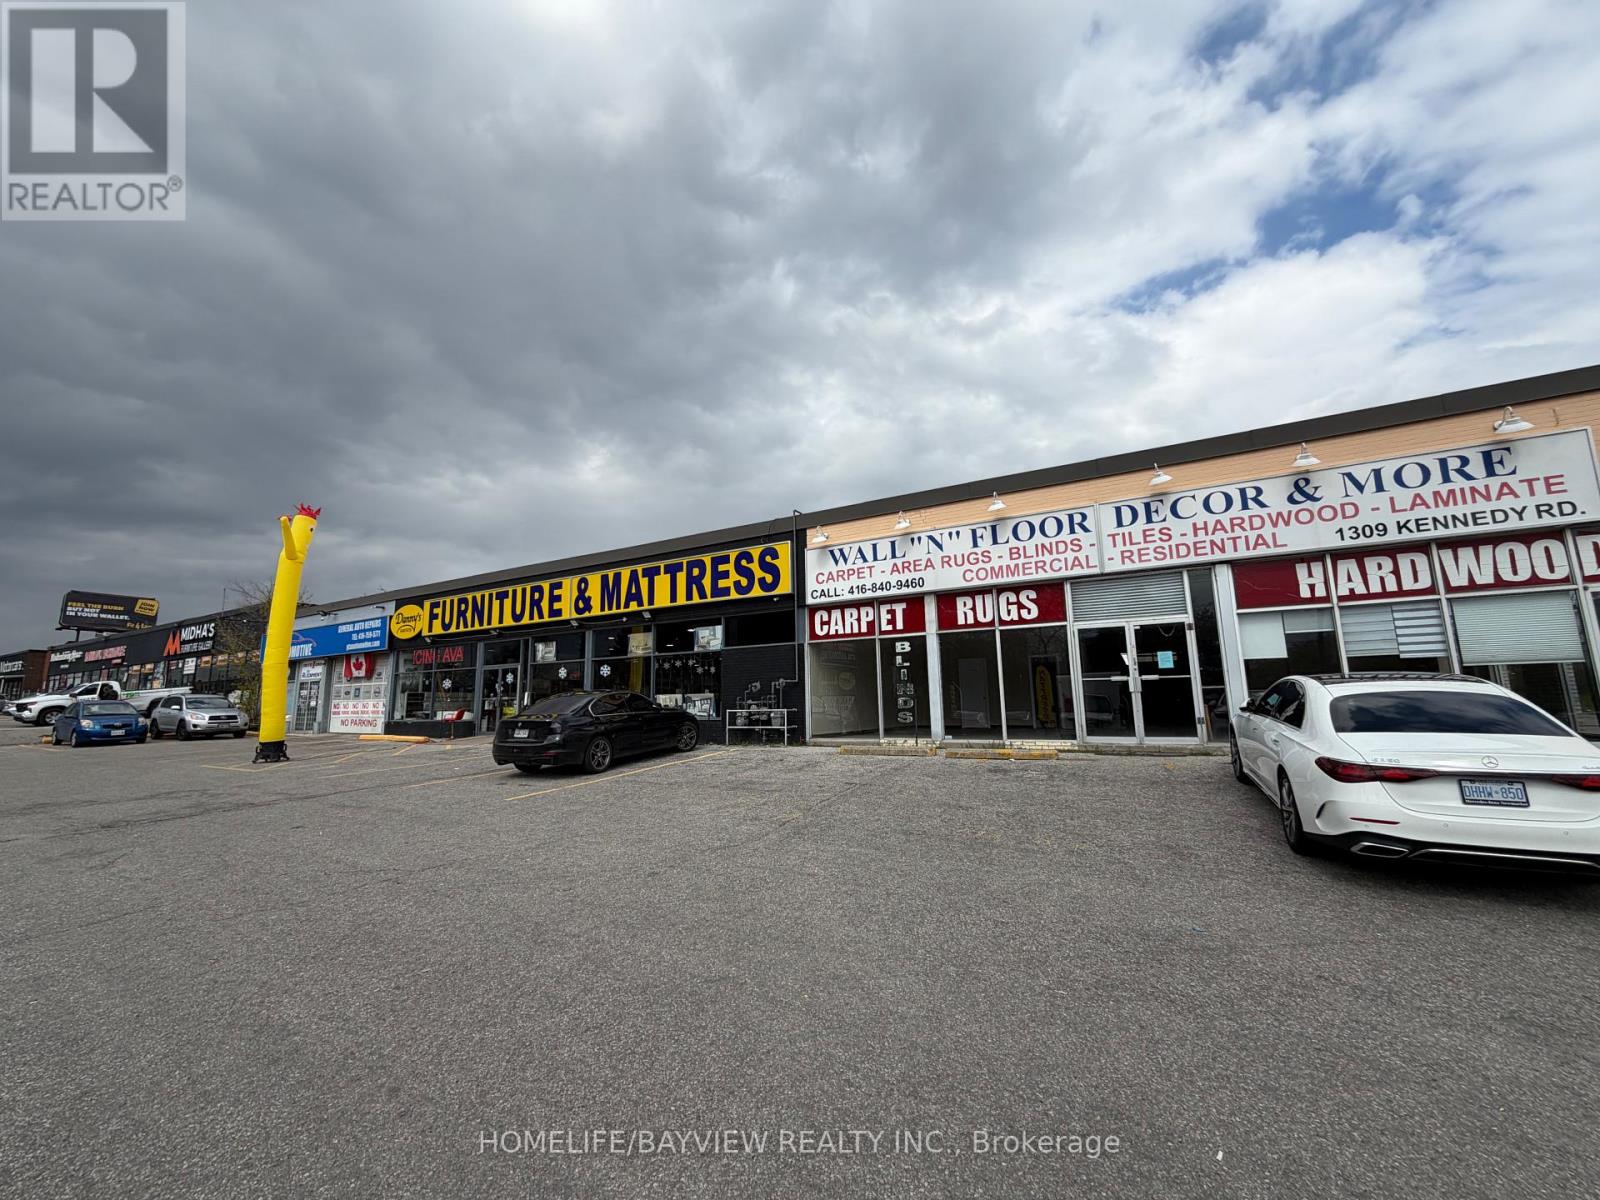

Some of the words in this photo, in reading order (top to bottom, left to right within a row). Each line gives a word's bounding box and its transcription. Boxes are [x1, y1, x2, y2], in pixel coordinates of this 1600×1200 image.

[829, 540, 906, 567] WALL
[911, 530, 961, 554] "N"
[970, 511, 1093, 548] FLOOR
[1113, 486, 1271, 529] DECOR
[1286, 477, 1323, 506] &
[1338, 447, 1518, 498] MORE
[1335, 523, 1388, 541] 1309
[1396, 506, 1528, 535] KENNEDY
[1535, 500, 1587, 519] RD.
[815, 566, 876, 585] CARPET
[890, 558, 936, 576] AREA
[941, 550, 992, 569] RUGS
[1009, 538, 1083, 561] BLINDS
[1107, 527, 1173, 548] TILES
[1191, 501, 1360, 537] HARDWOOD
[1389, 474, 1568, 514] LAMINATE
[962, 555, 1098, 583] COMMERCIAL
[1120, 533, 1287, 565] RESIDENTIAL
[428, 581, 563, 633] FURNITURE
[573, 577, 593, 616] &
[600, 546, 781, 612] MATTRESS
[810, 588, 844, 600] CALL:
[848, 577, 925, 595] 416-840-9460
[396, 612, 421, 632] Danny's
[814, 602, 907, 636] CARPET
[956, 589, 1039, 625] RUGS
[180, 622, 215, 642] MIDHA'S
[340, 719, 350, 727] NO
[350, 718, 378, 728] PARKING
